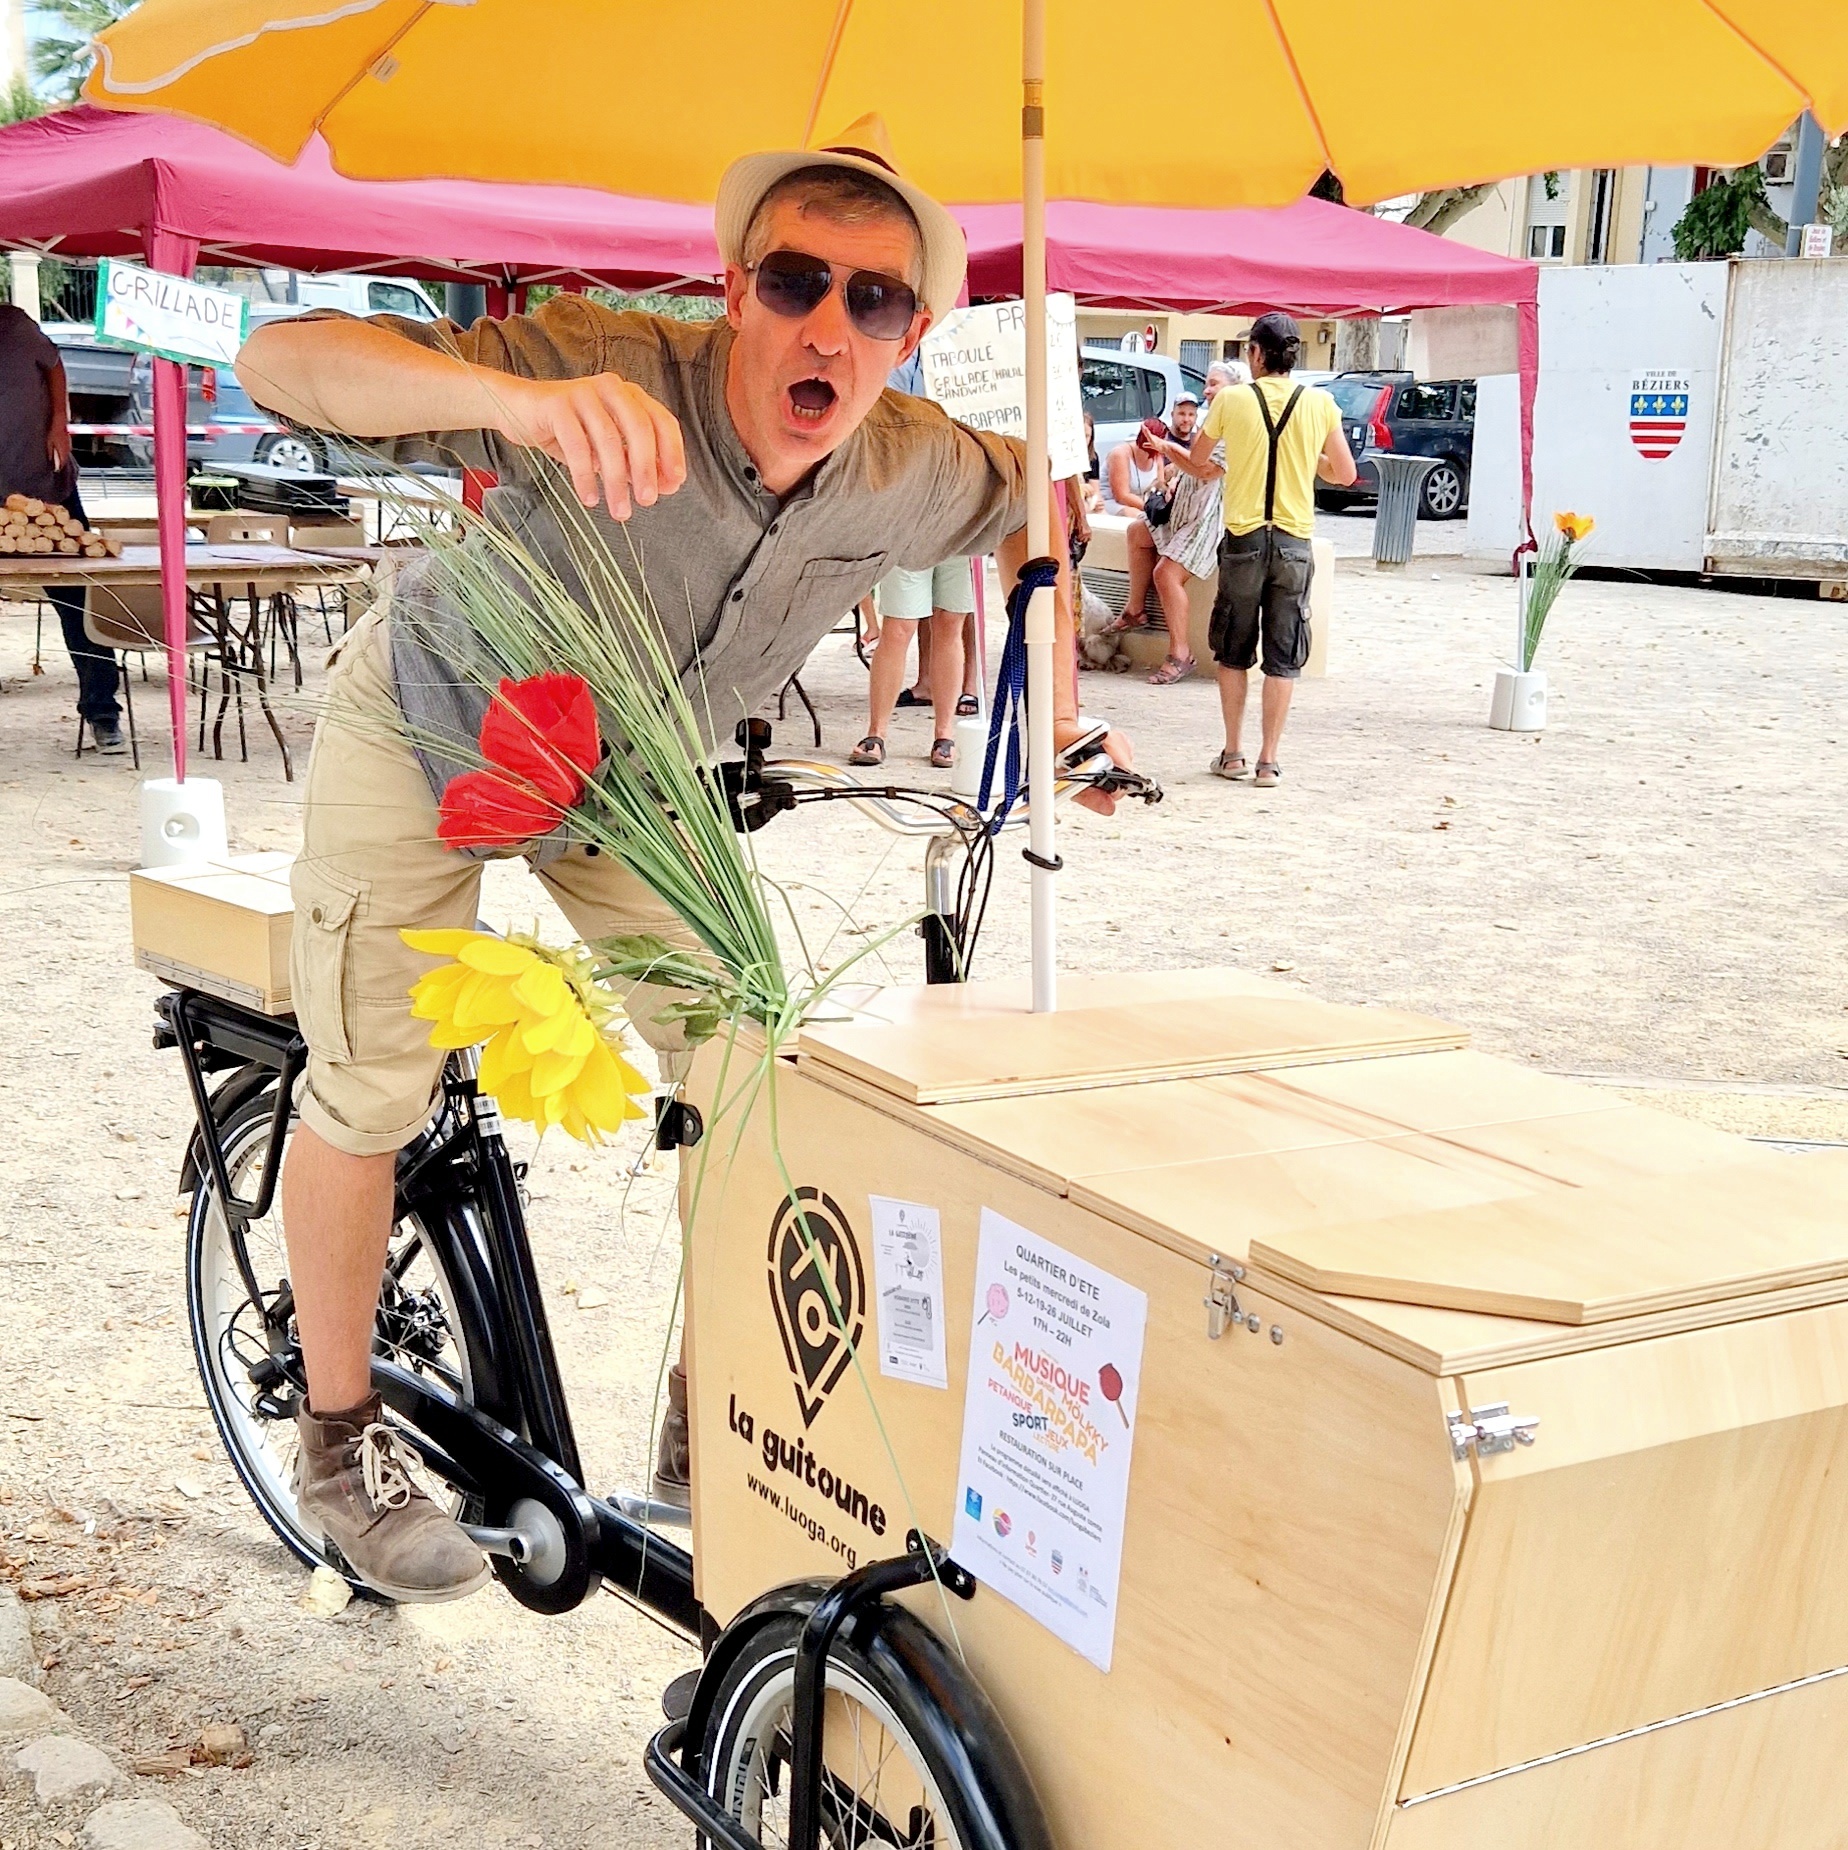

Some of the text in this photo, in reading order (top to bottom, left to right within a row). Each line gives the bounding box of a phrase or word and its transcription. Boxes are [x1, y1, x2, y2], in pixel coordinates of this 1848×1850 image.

[112, 271, 236, 330] GRILLADE
[934, 369, 990, 391] GRILLADE
[935, 382, 998, 402] SANDWICH
[1632, 379, 1690, 391] BÉZIERS
[1004, 1260, 1111, 1329] Les petits mercredi de Zola
[1016, 1245, 1100, 1301] QUARTIER D'ETE
[1017, 1287, 1093, 1339] 5-12-19-26 JUILLET
[1033, 1316, 1048, 1333] 17H
[1056, 1329, 1072, 1347] 22H
[988, 1377, 1033, 1414] PETANQUE
[1014, 1341, 1091, 1406] MUSIQUE
[992, 1340, 1097, 1468] BARBARPAPA
[1012, 1412, 1048, 1431] SPORT
[1061, 1391, 1109, 1453] MÖLKKY
[999, 1430, 1084, 1491] RESTAURATION SUR PLACE
[1046, 1428, 1069, 1450] JEUX
[762, 1428, 887, 1536] guitoune
[747, 1472, 857, 1570] www.luoga.org
